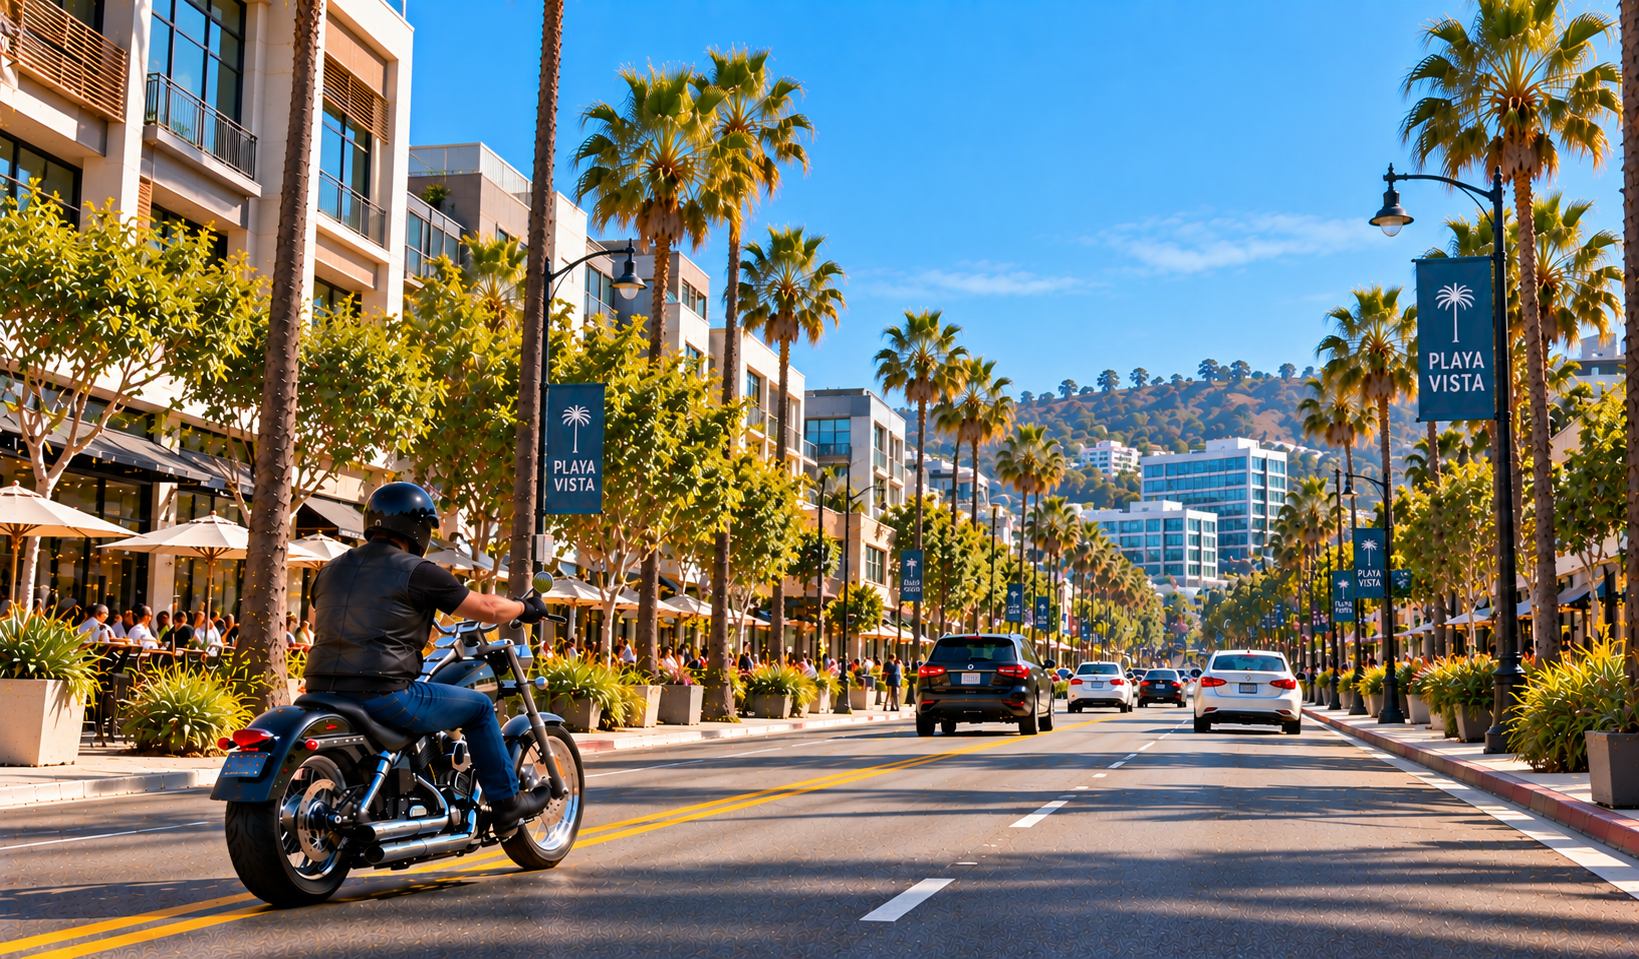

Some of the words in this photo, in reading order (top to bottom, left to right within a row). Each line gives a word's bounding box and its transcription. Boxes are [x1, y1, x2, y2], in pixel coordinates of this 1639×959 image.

[1429, 351, 1485, 370] PLAYA
[1428, 373, 1485, 392] VISTA
[554, 459, 596, 474] PLAYA
[554, 477, 595, 492] VISTA
[1357, 569, 1381, 577] PLAYA
[1358, 578, 1381, 587] VISTA
